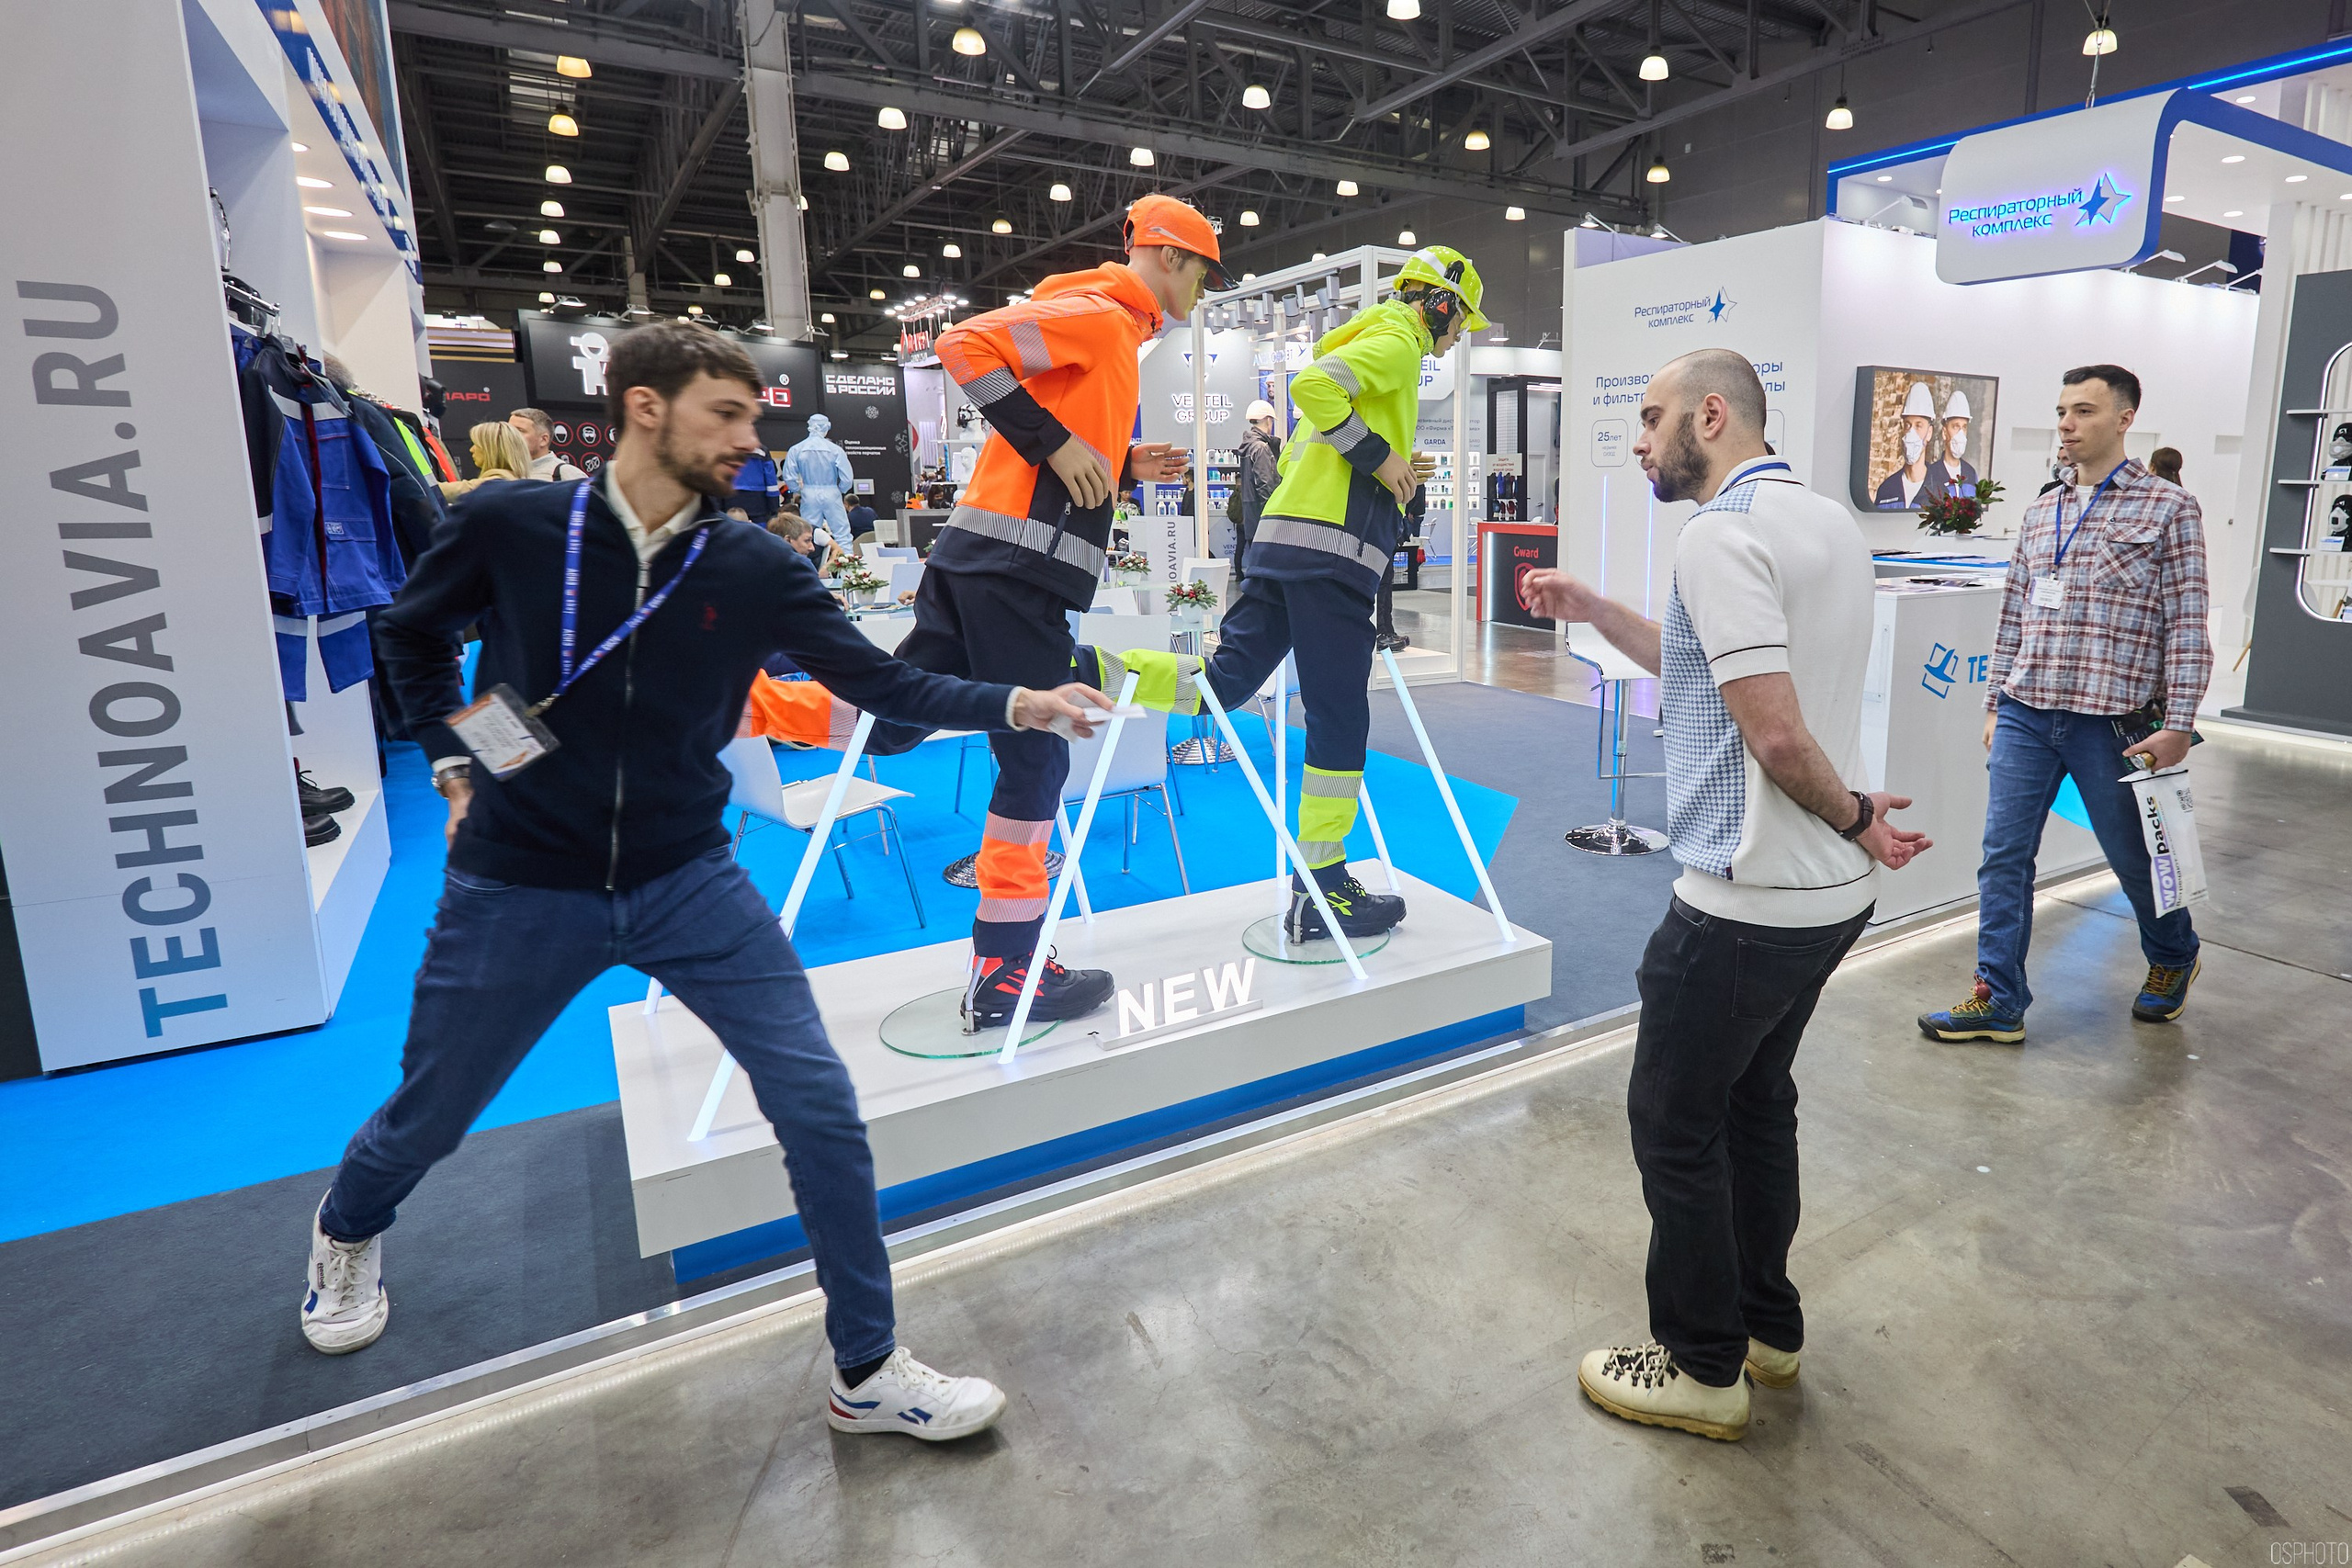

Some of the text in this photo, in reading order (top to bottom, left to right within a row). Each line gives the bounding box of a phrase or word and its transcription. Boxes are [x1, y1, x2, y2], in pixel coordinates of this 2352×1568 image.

[1949, 188, 2084, 224] Респираторный
[1973, 214, 2053, 236] комплекс
[1634, 296, 1711, 318] Респираторный
[1648, 313, 1694, 328] комплекс
[1420, 359, 1441, 370] EIL
[1753, 362, 1782, 376] оры
[826, 375, 895, 385] СДЕЛАНО
[1596, 374, 1653, 389] Произво
[1764, 381, 1785, 392] лы
[827, 385, 896, 396] В РОССИИ
[1172, 395, 1232, 406] VETEIL
[1593, 397, 1600, 405] и
[1177, 411, 1229, 422] GRUP
[1513, 546, 1539, 558] Gward
[16, 280, 229, 1038] TECHNOAVIA.RU
[1115, 957, 1256, 1037] NEW
